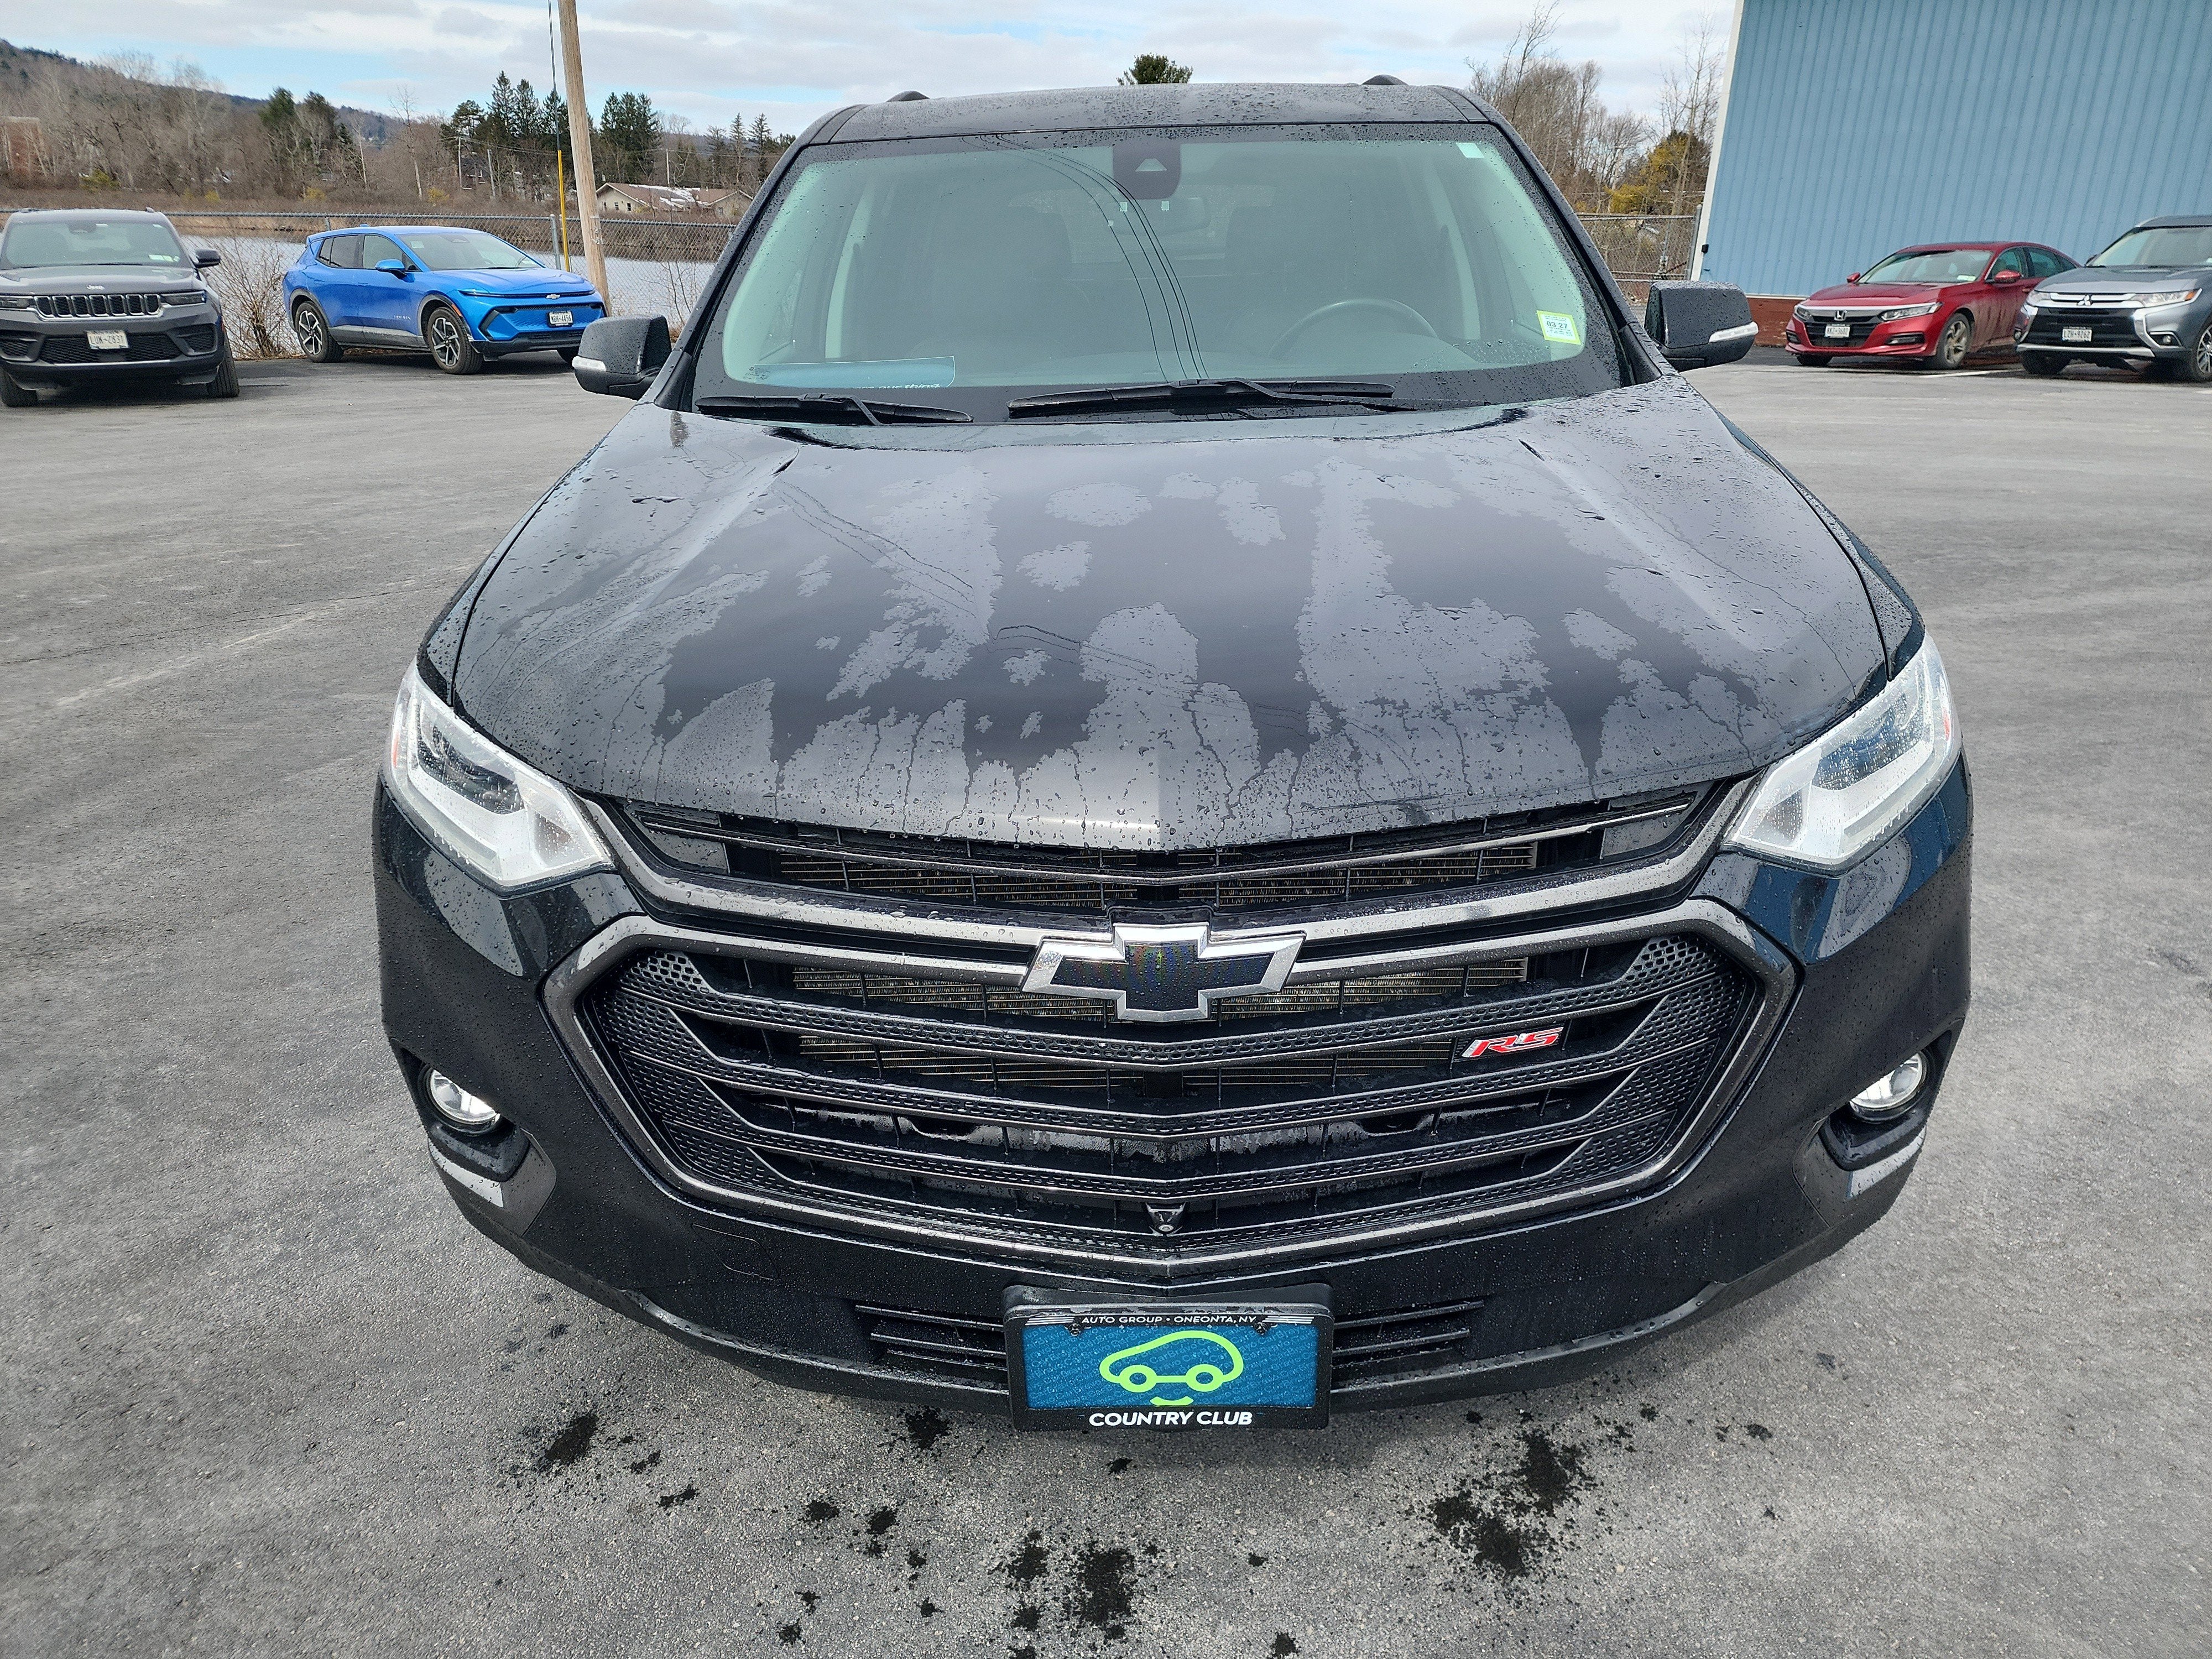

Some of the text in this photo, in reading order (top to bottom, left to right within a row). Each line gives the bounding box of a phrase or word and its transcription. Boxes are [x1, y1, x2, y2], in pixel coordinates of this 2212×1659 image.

[1462, 1026, 1564, 1058] RS
[1173, 1315, 1238, 1324] ONEONTA,
[1089, 1411, 1253, 1427] COUNTRY CLUB
